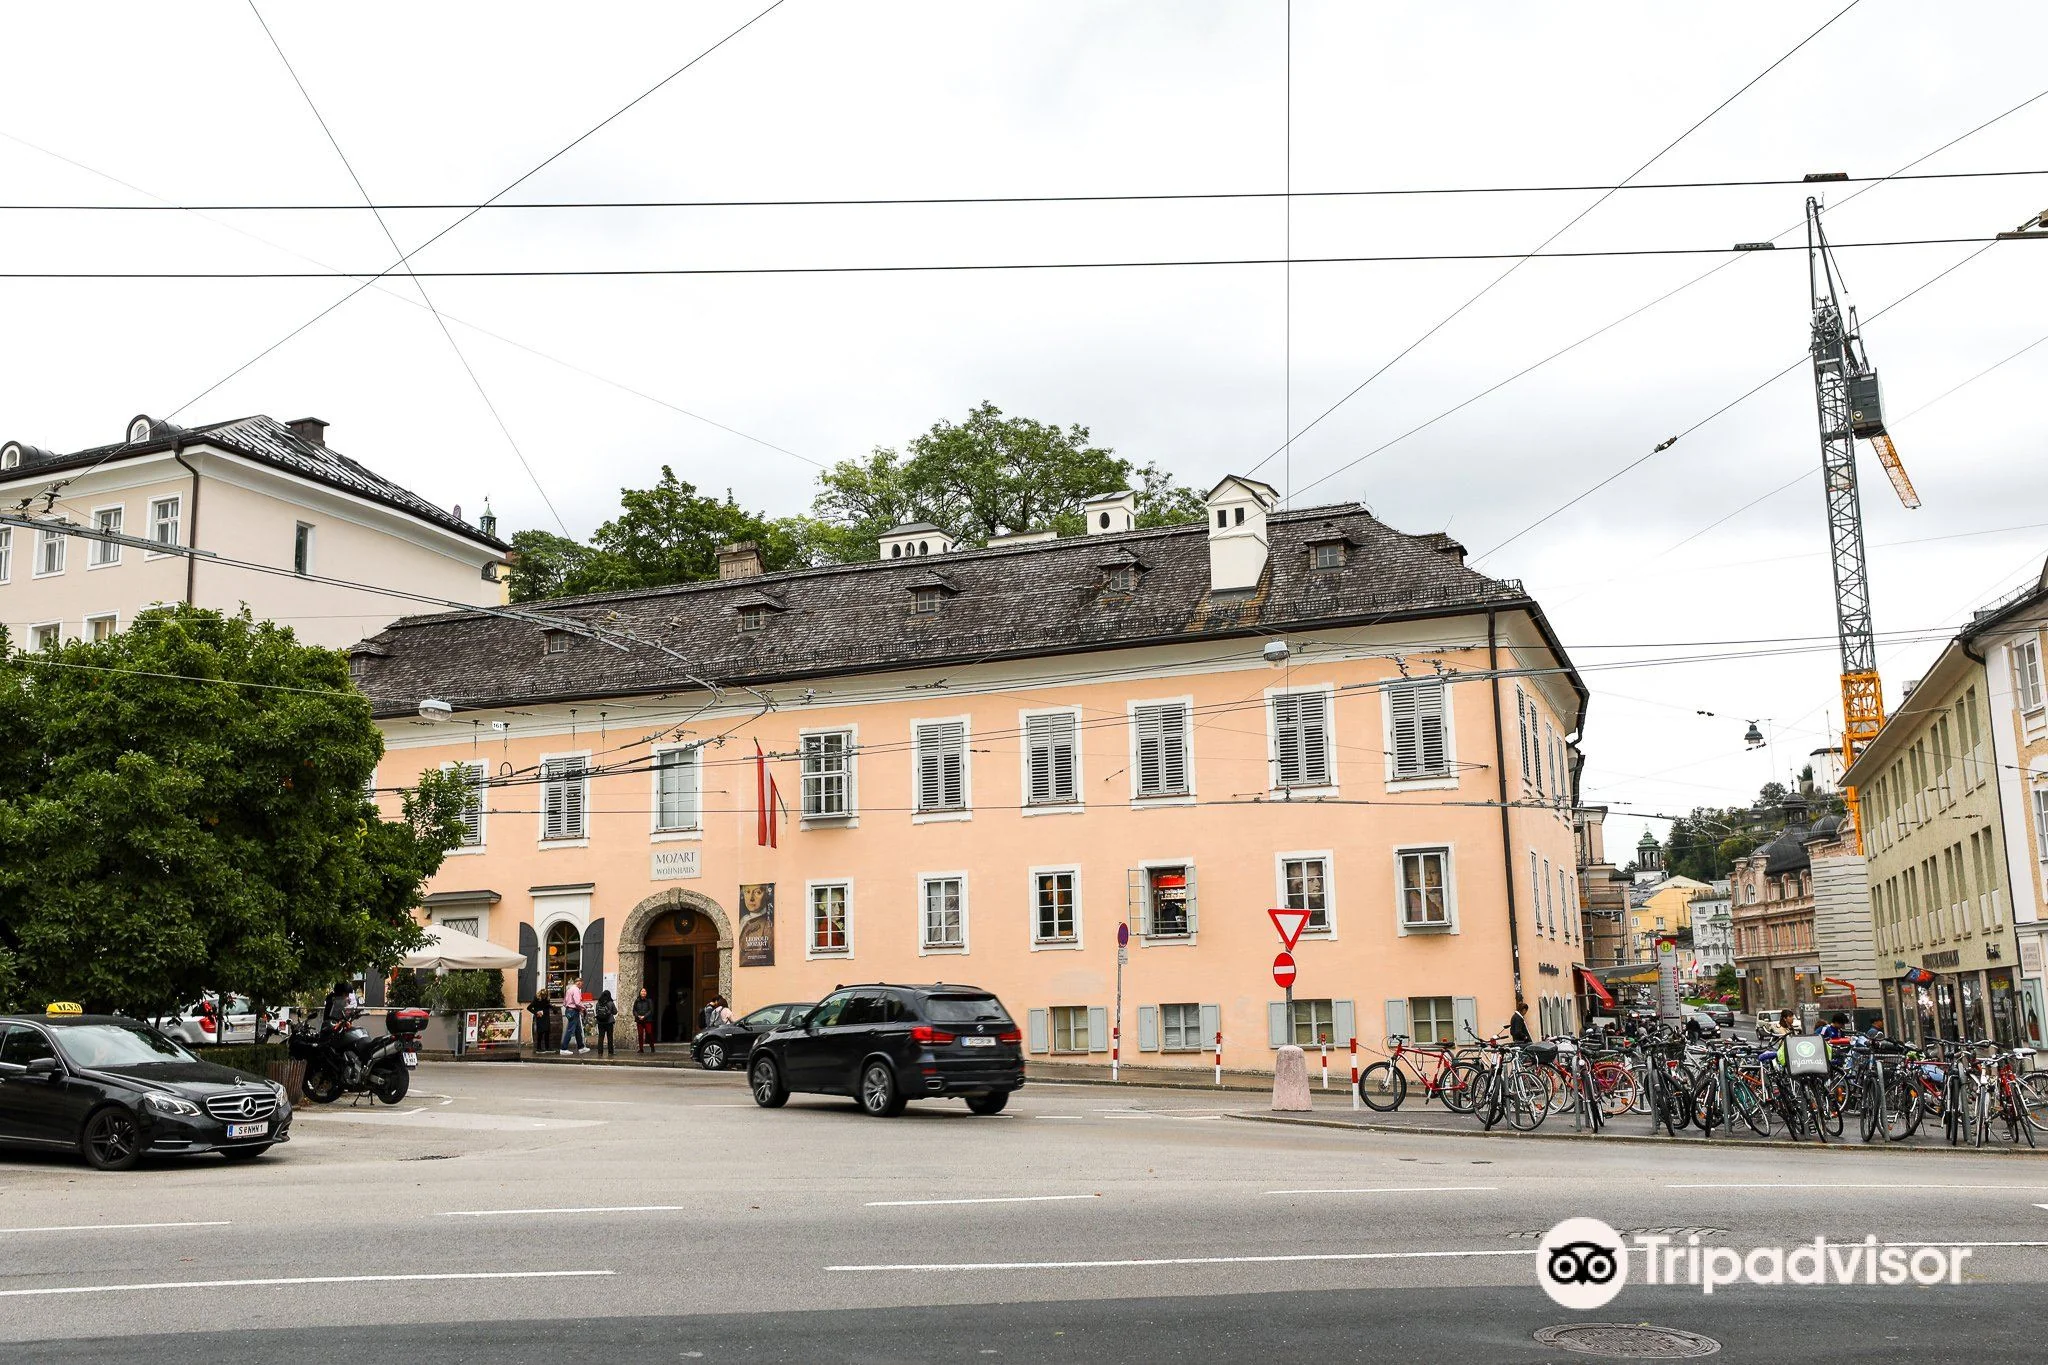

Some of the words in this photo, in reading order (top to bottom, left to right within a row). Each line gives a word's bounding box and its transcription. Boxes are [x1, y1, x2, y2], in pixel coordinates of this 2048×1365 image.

[656, 851, 696, 864] MOZART
[656, 866, 695, 875] WOHNHAUS
[56, 1003, 81, 1011] TAXI
